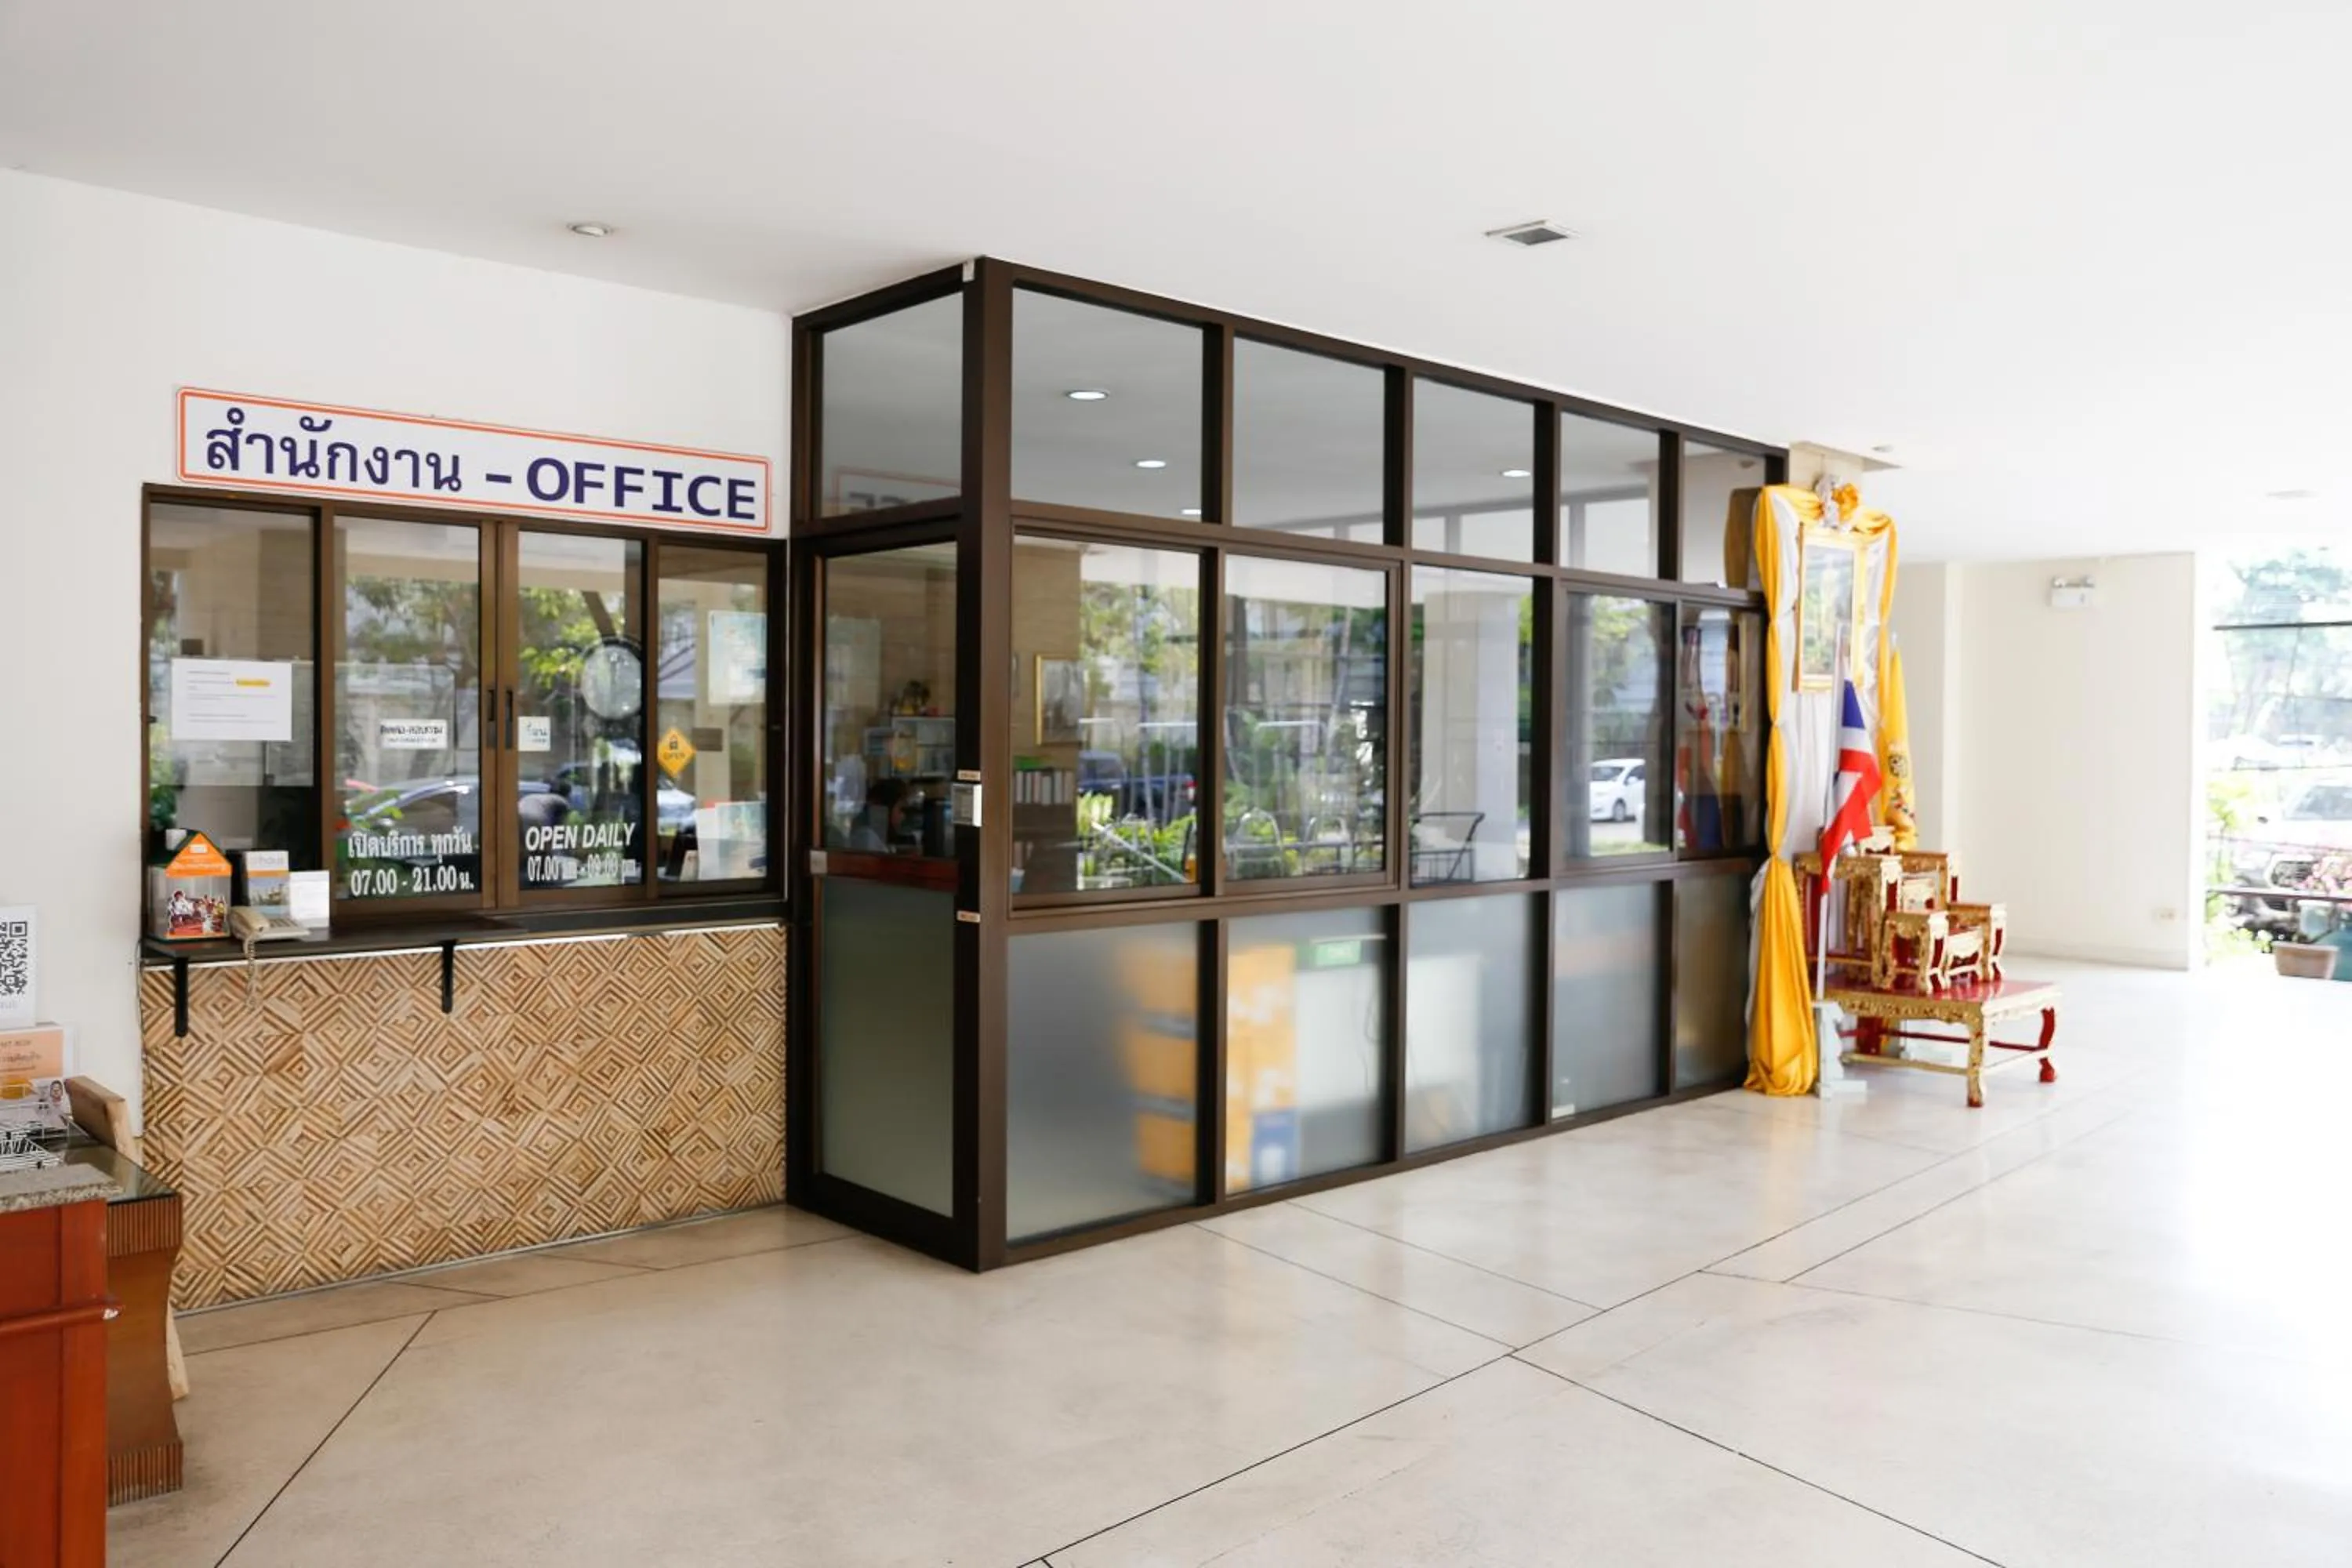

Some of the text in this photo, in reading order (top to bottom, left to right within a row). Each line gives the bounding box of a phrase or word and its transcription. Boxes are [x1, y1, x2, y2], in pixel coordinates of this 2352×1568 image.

[206, 407, 462, 492] สำนักงาน
[526, 457, 756, 521] OFFICE
[348, 826, 473, 864] เปิดบริการ ทุกวัน
[525, 822, 636, 851] OPEN DAILY
[351, 869, 397, 897] 07.00
[412, 865, 457, 892] 21.00
[528, 855, 559, 881] 07.00
